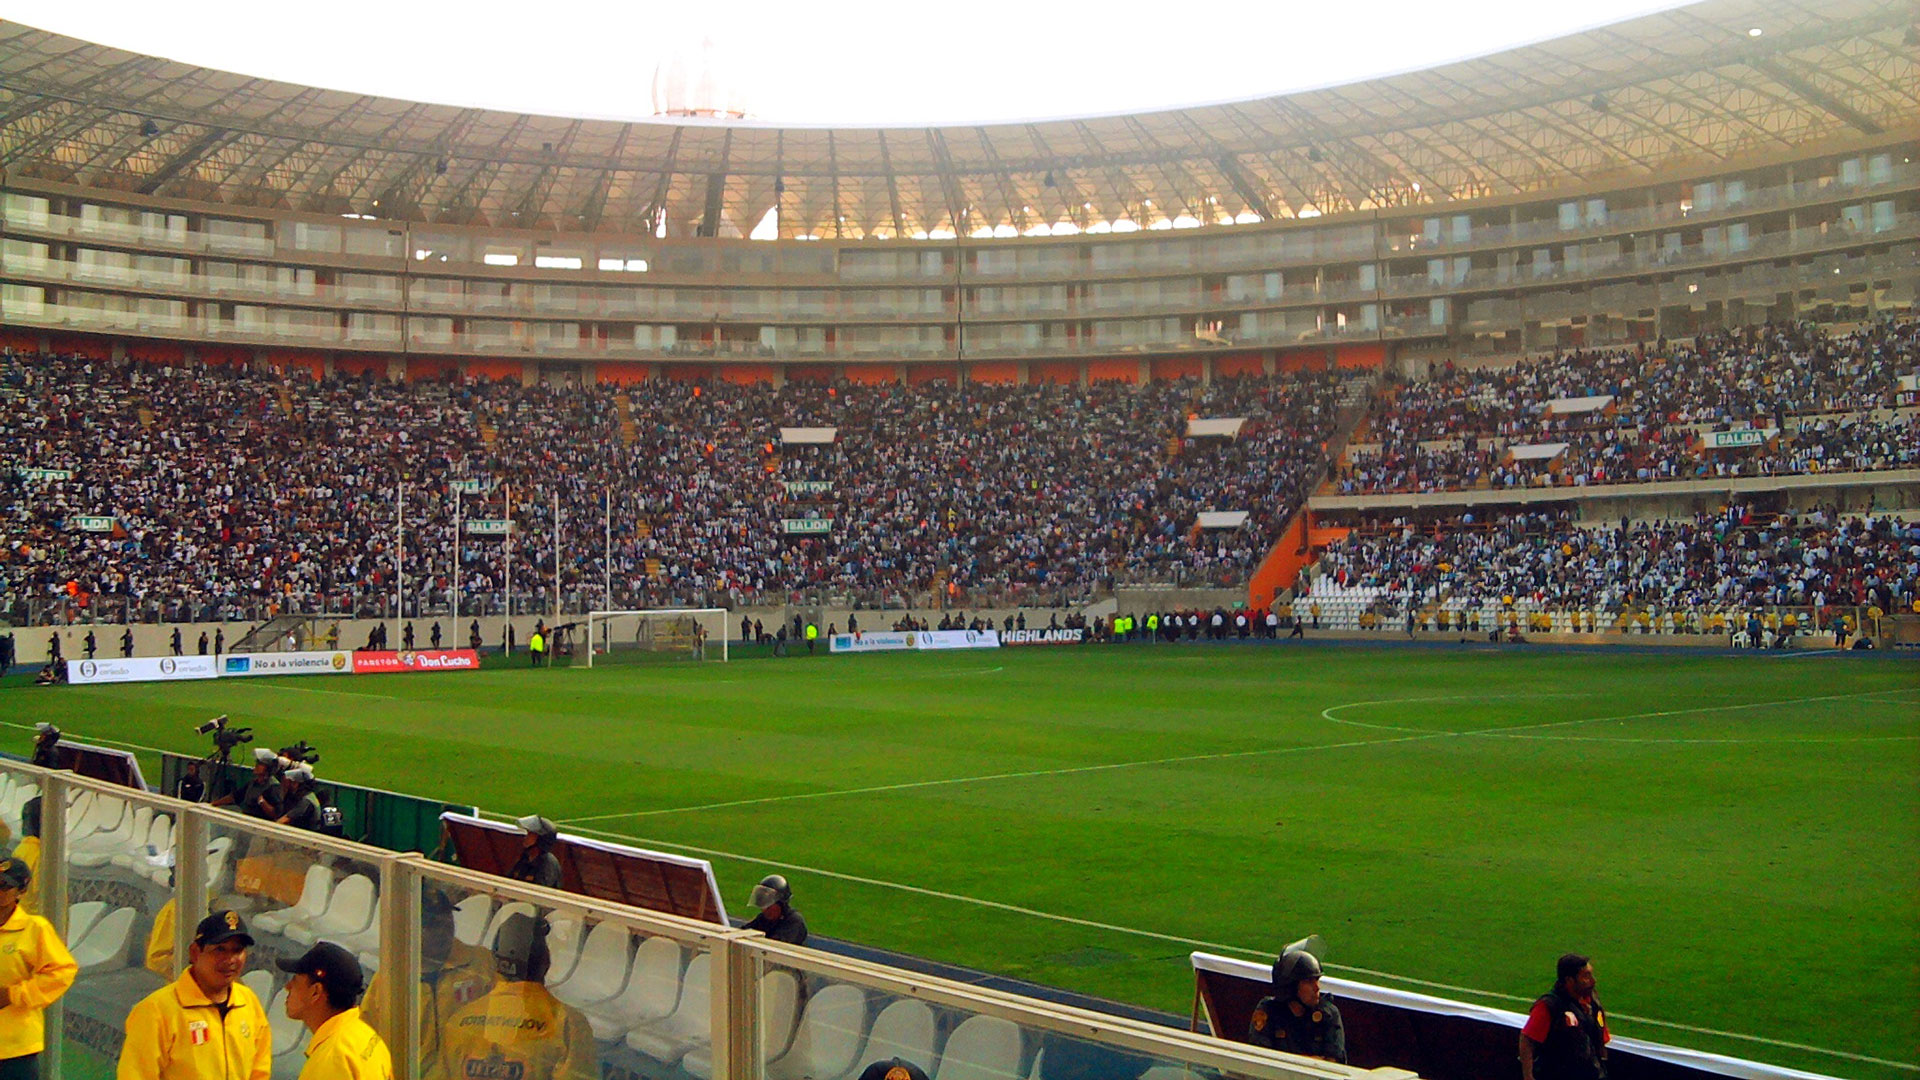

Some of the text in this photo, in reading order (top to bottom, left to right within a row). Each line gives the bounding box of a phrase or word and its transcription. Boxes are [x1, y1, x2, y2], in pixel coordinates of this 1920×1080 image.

[1717, 432, 1761, 445] SALIDA
[789, 520, 829, 530] SALIDA
[1001, 629, 1083, 642] HIGHLANDS
[254, 660, 268, 668] No
[278, 659, 287, 667] la
[289, 657, 330, 668] violencia
[417, 655, 440, 667] Don
